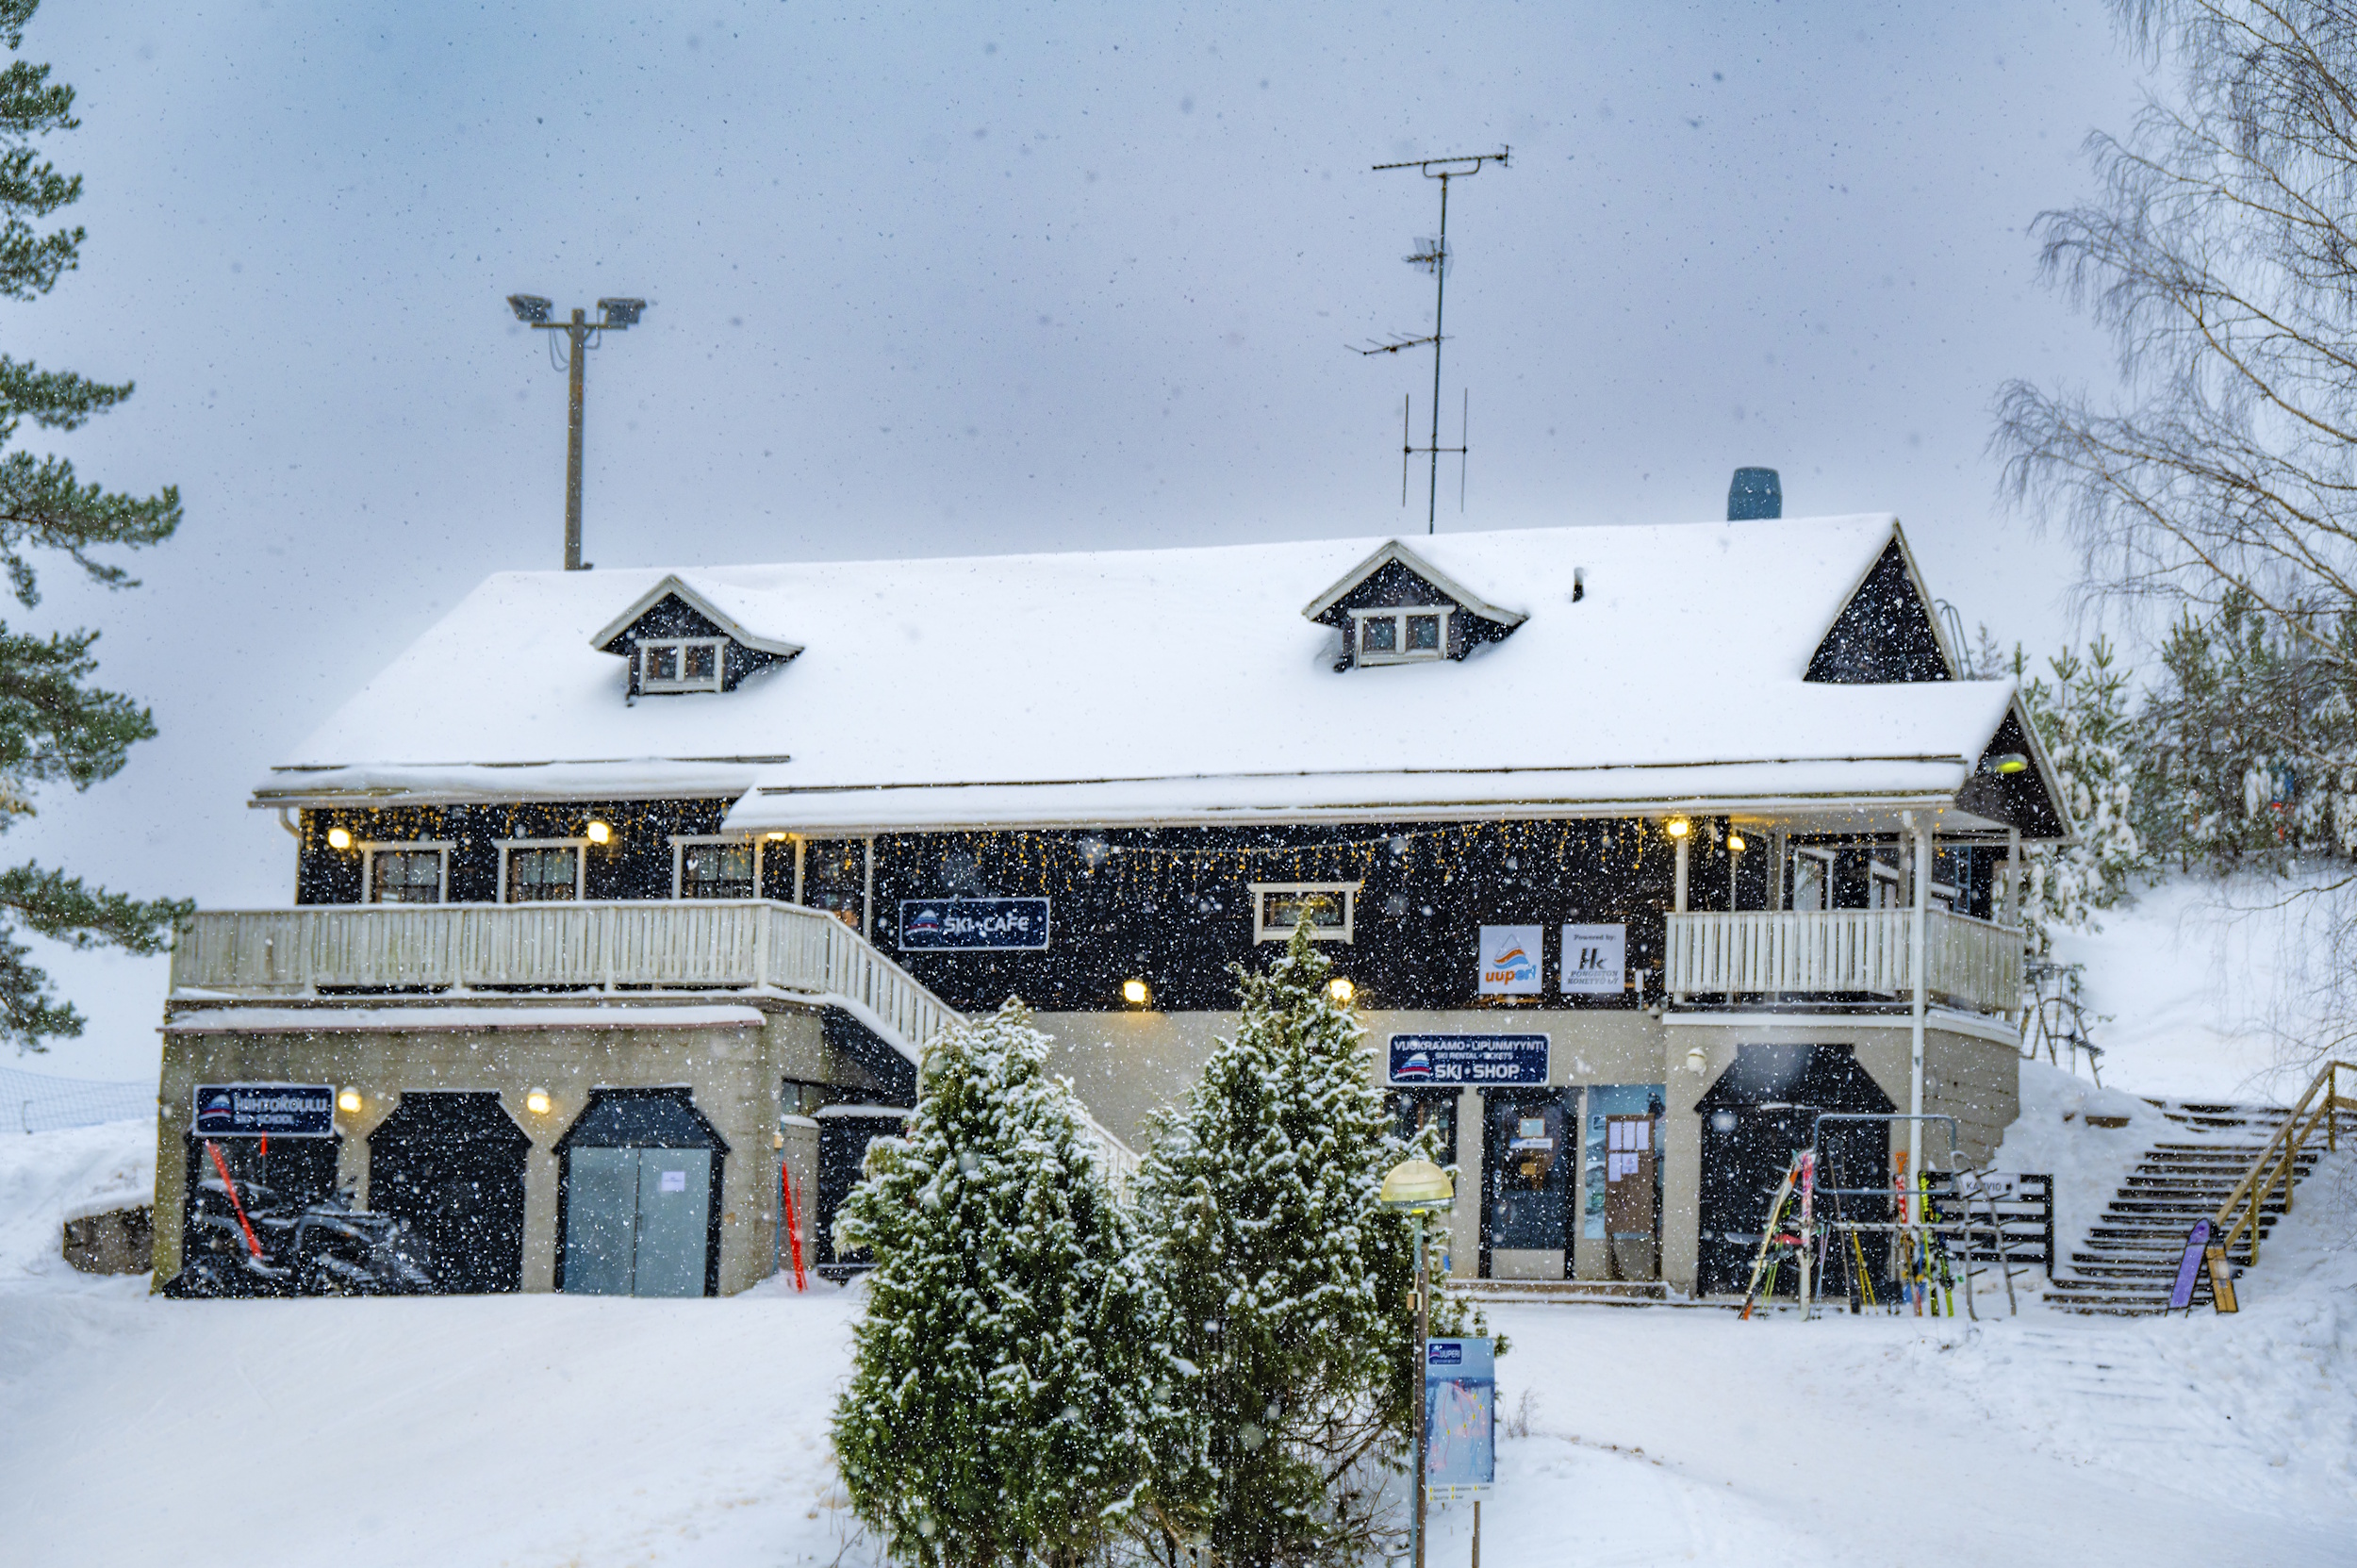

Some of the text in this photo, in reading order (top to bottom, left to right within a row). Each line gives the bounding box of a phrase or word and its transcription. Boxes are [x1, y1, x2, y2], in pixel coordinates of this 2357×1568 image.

[944, 916, 1030, 933] SKI CAFE
[1485, 965, 1537, 985] uuperi
[1394, 1039, 1544, 1051] VUOKRAAMO LIPUNMYYNTI
[1435, 1051, 1448, 1060] SKI
[1449, 1051, 1477, 1060] RENTAL
[1434, 1064, 1520, 1080] SKI SHOP
[234, 1098, 328, 1113] HIIHTOKOULU
[1966, 1181, 2002, 1192] KAVIO
